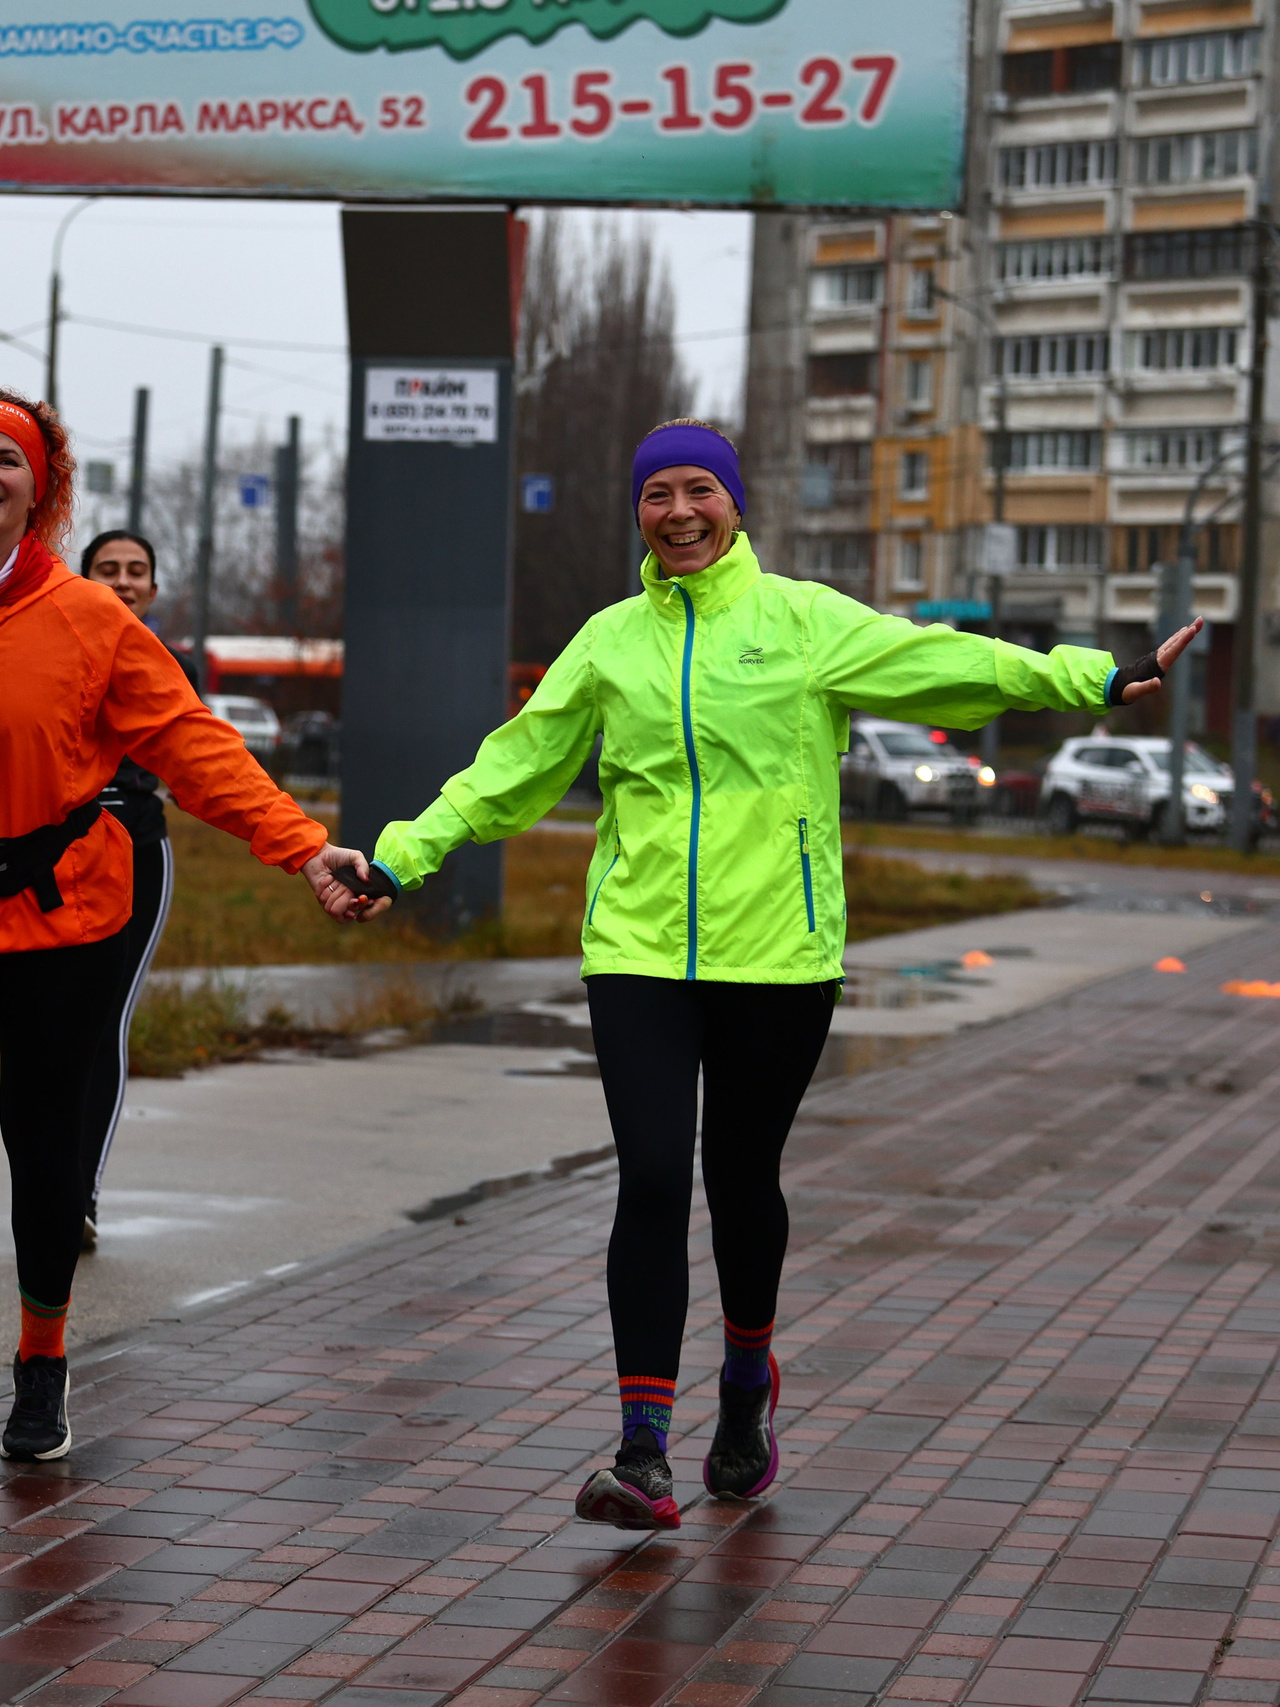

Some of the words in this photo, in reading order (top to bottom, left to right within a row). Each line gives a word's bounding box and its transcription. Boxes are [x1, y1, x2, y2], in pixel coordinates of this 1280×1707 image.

[466, 57, 896, 140] 215-15-27
[59, 104, 183, 134] КАРЛА
[197, 99, 365, 134] МАРКСА,
[379, 97, 424, 128] 52
[6, 405, 31, 425] ULTRA
[738, 658, 765, 666] NORVEG
